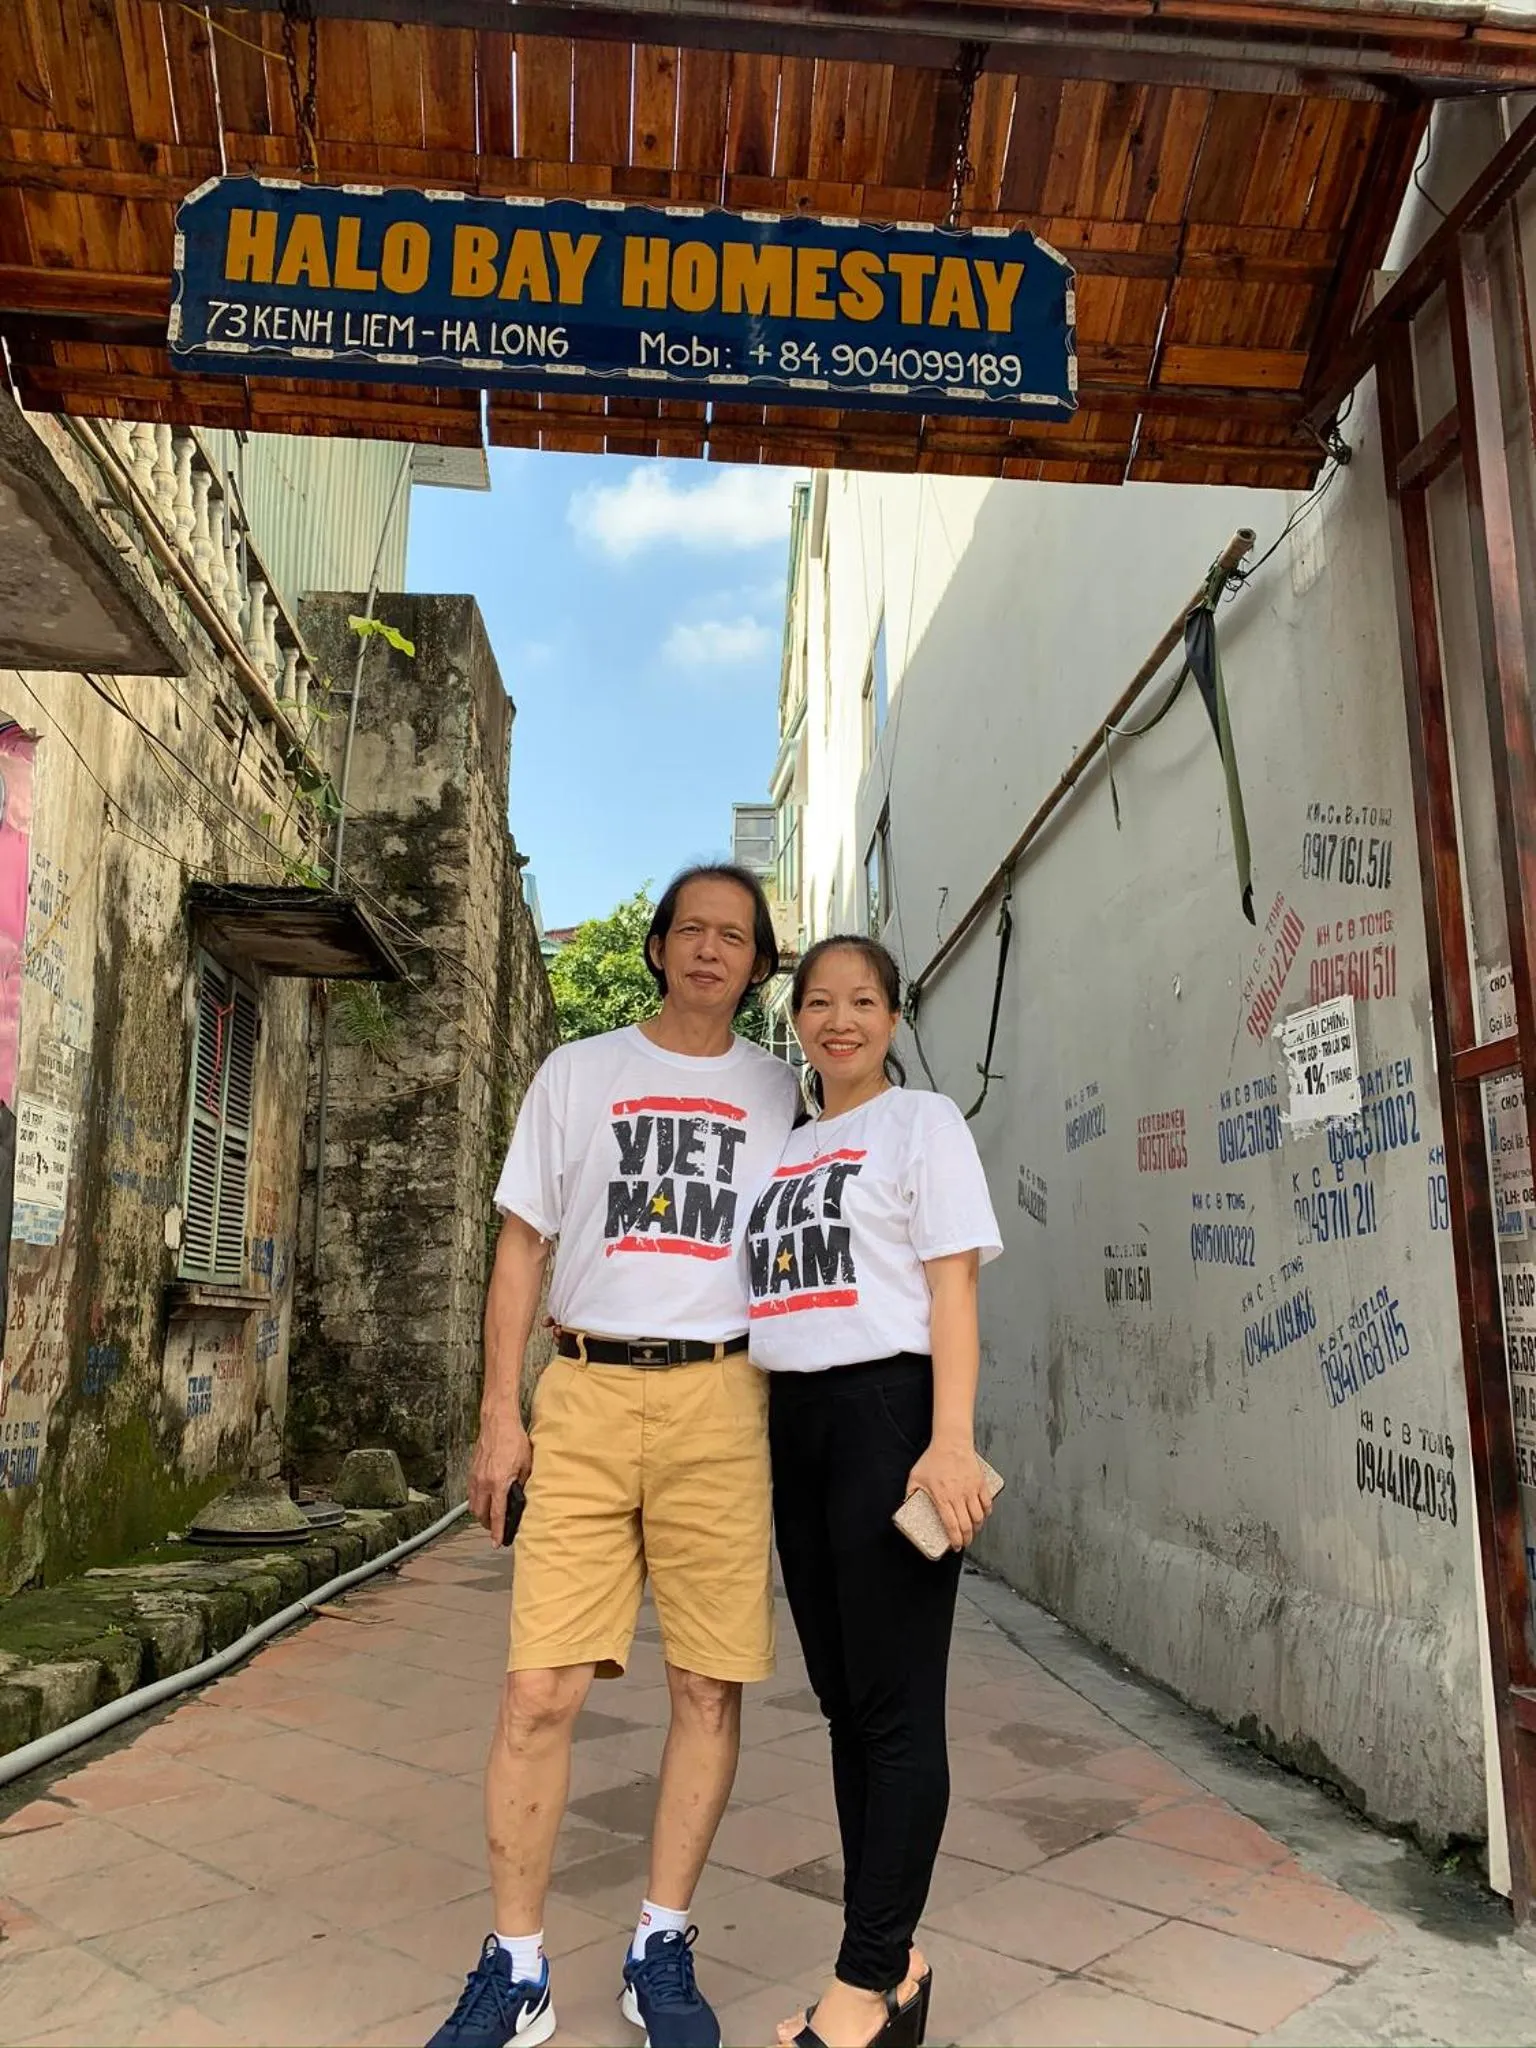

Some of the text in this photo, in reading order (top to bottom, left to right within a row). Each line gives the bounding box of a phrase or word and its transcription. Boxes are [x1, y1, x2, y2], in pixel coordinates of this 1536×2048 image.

[225, 208, 1024, 333] HALO BAY HOMESTAY
[345, 313, 415, 349] LIEM
[442, 322, 479, 352] HA
[490, 322, 569, 358] LONG
[1253, 1074, 1277, 1100] TONG
[1304, 1062, 1326, 1096] 1%
[611, 1115, 747, 1184] VIET
[1312, 1167, 1321, 1188] C
[604, 1177, 738, 1244] NAM
[1384, 1416, 1391, 1437] C
[1402, 1423, 1411, 1445] B
